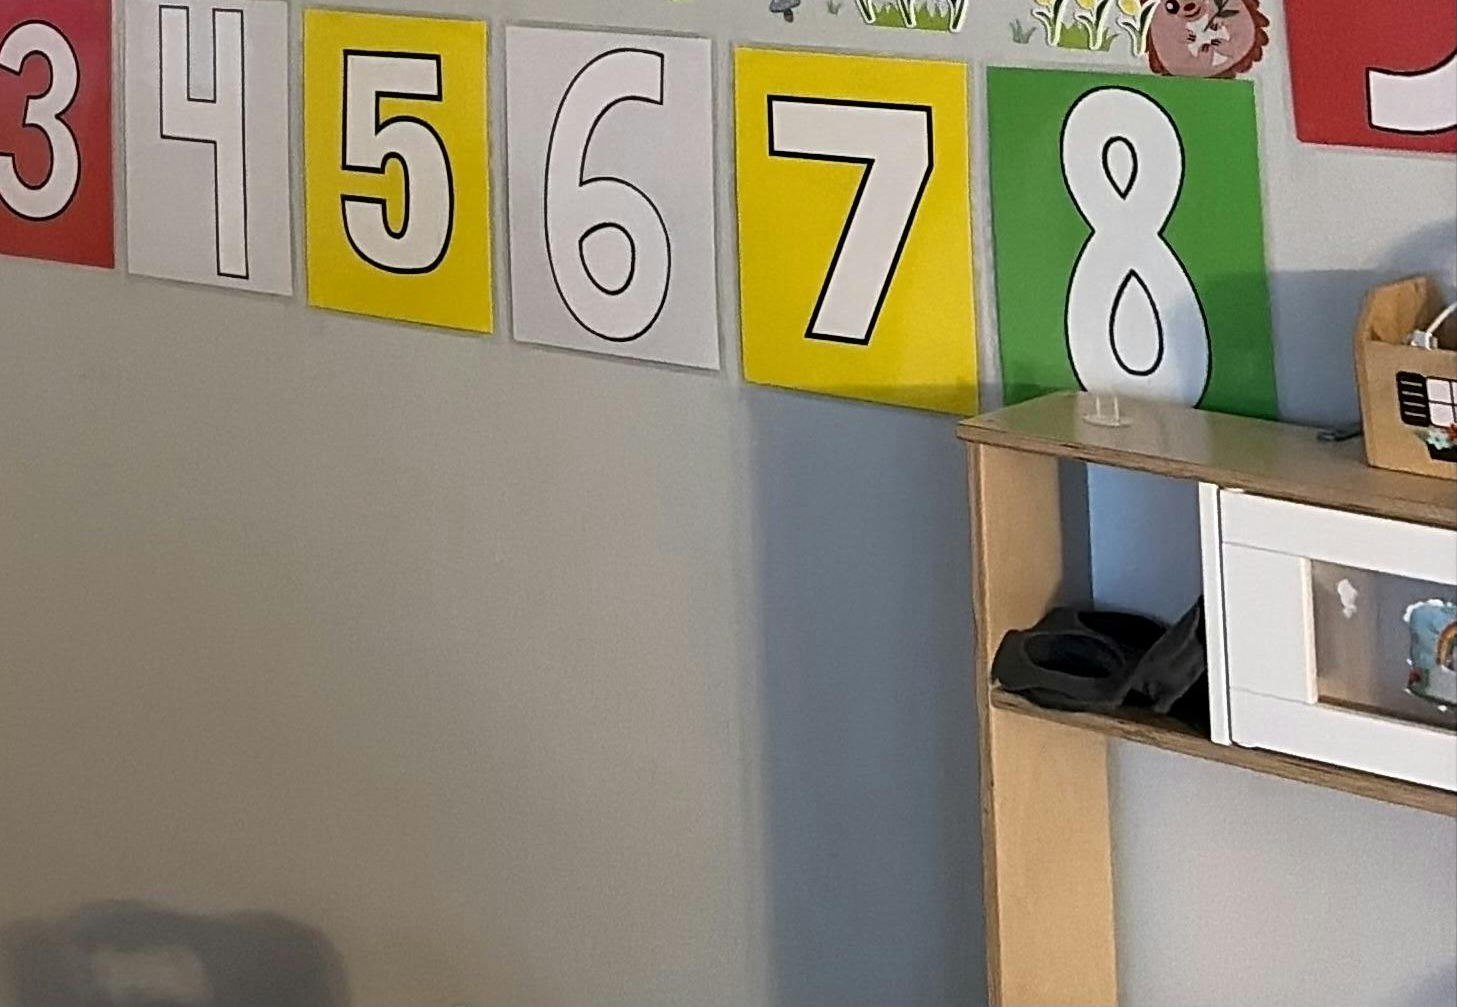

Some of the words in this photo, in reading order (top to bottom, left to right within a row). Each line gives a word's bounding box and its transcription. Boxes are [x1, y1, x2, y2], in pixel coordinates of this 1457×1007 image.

[159, 4, 249, 281] 4
[340, 48, 455, 276] 5
[544, 46, 673, 343] 6
[766, 93, 934, 346] 7
[1058, 84, 1212, 410] 8
